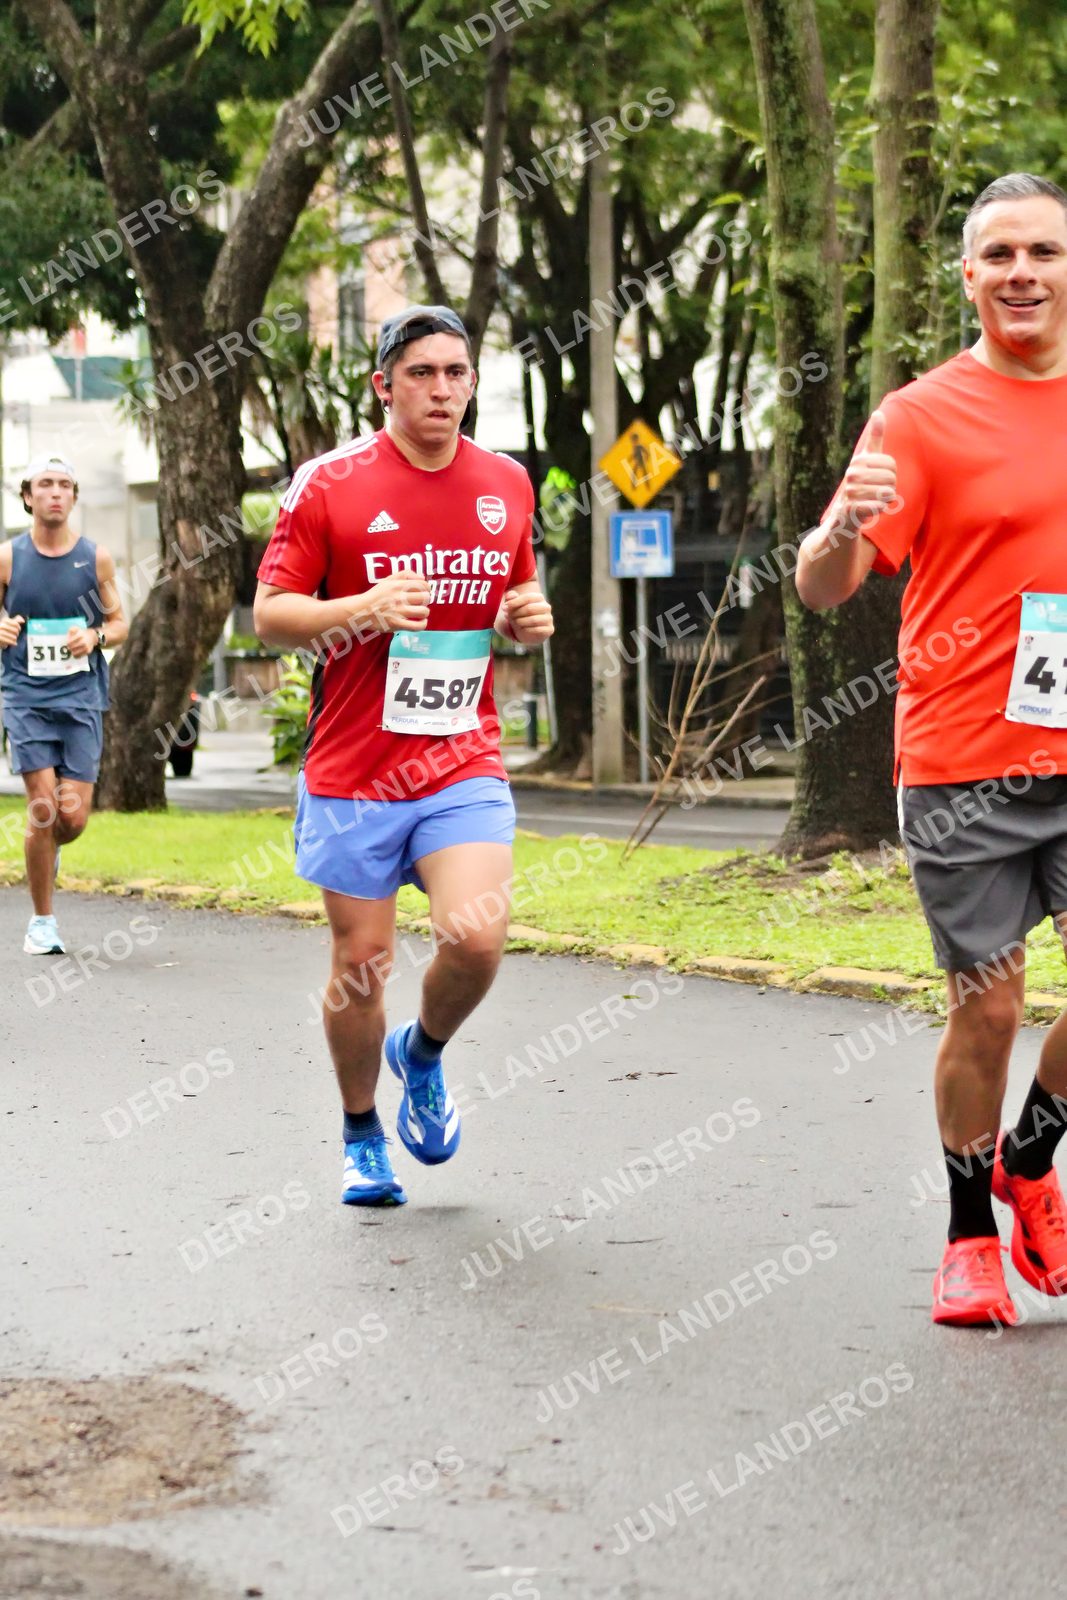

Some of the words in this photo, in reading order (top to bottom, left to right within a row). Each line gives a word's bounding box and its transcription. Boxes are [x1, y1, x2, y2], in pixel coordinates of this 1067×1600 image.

[367, 523, 400, 533] adidas
[363, 544, 511, 584] Emirates
[33, 645, 78, 661] 319
[394, 676, 482, 710] 4587
